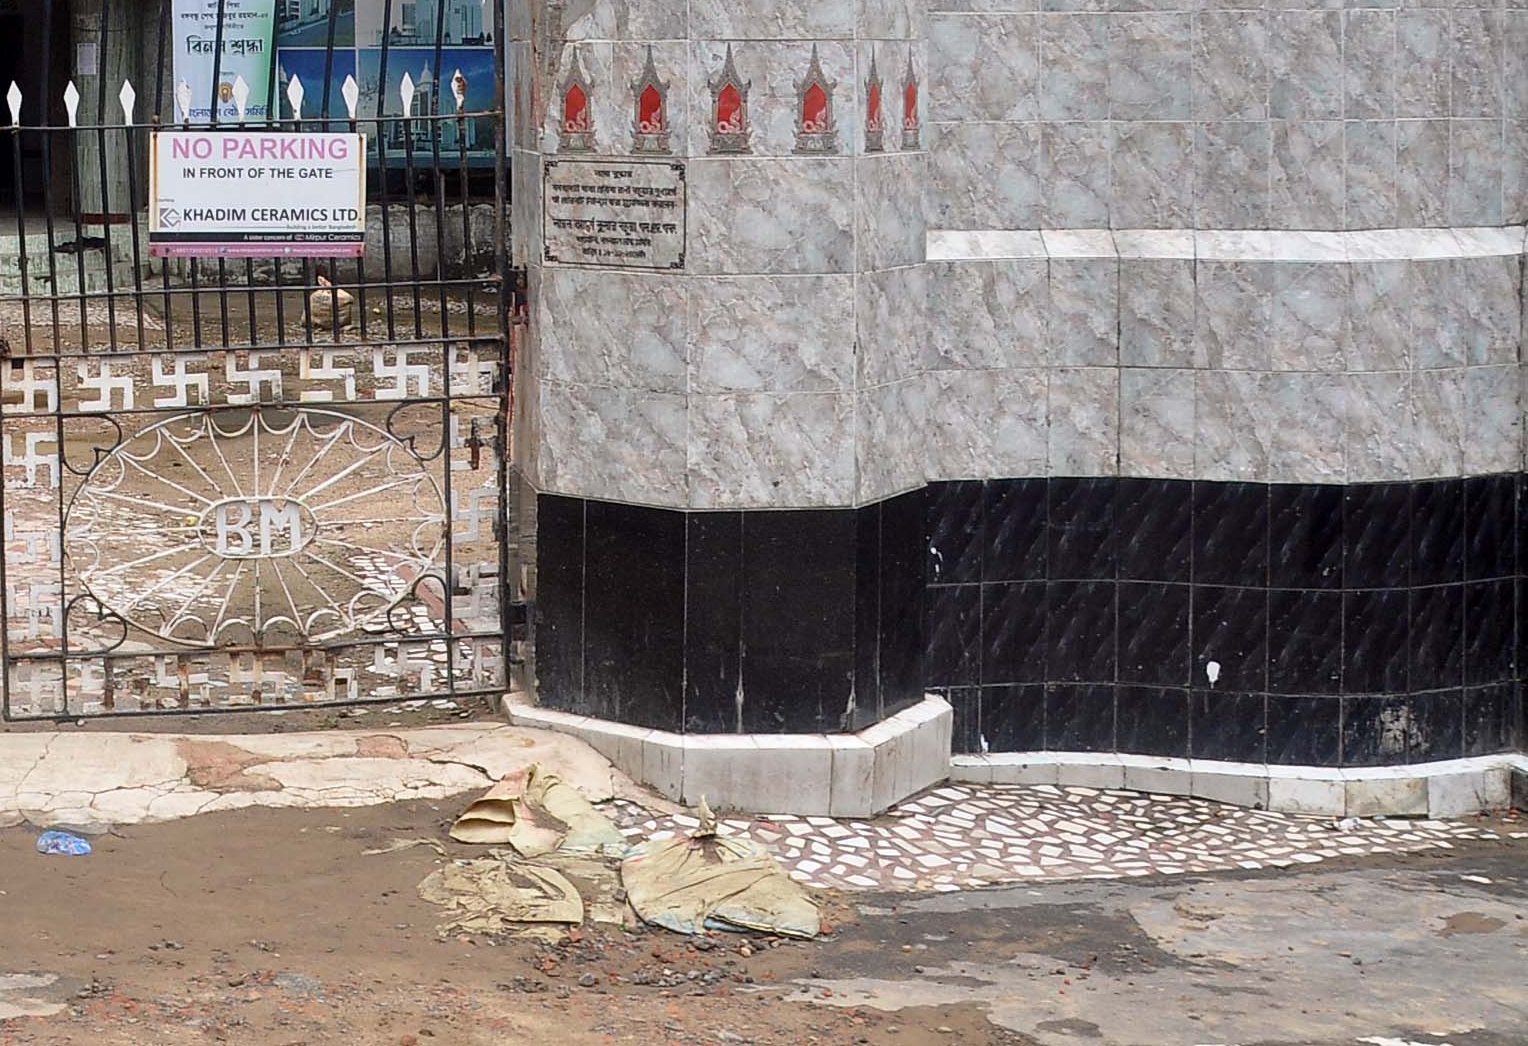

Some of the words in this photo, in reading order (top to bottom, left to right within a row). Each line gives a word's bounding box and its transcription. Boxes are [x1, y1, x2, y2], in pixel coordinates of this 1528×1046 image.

[172, 137, 212, 160] NO
[222, 137, 348, 160] PARKING
[183, 168, 195, 179] IN
[199, 168, 243, 179] FRONT
[247, 168, 265, 179] OF
[270, 168, 295, 179] THE
[298, 168, 333, 179] GATE
[183, 208, 246, 222] KHADIM
[251, 208, 328, 222] CERAMICS
[332, 208, 362, 222] LTD.
[305, 234, 327, 242] Mirpur
[216, 500, 301, 556] BM
